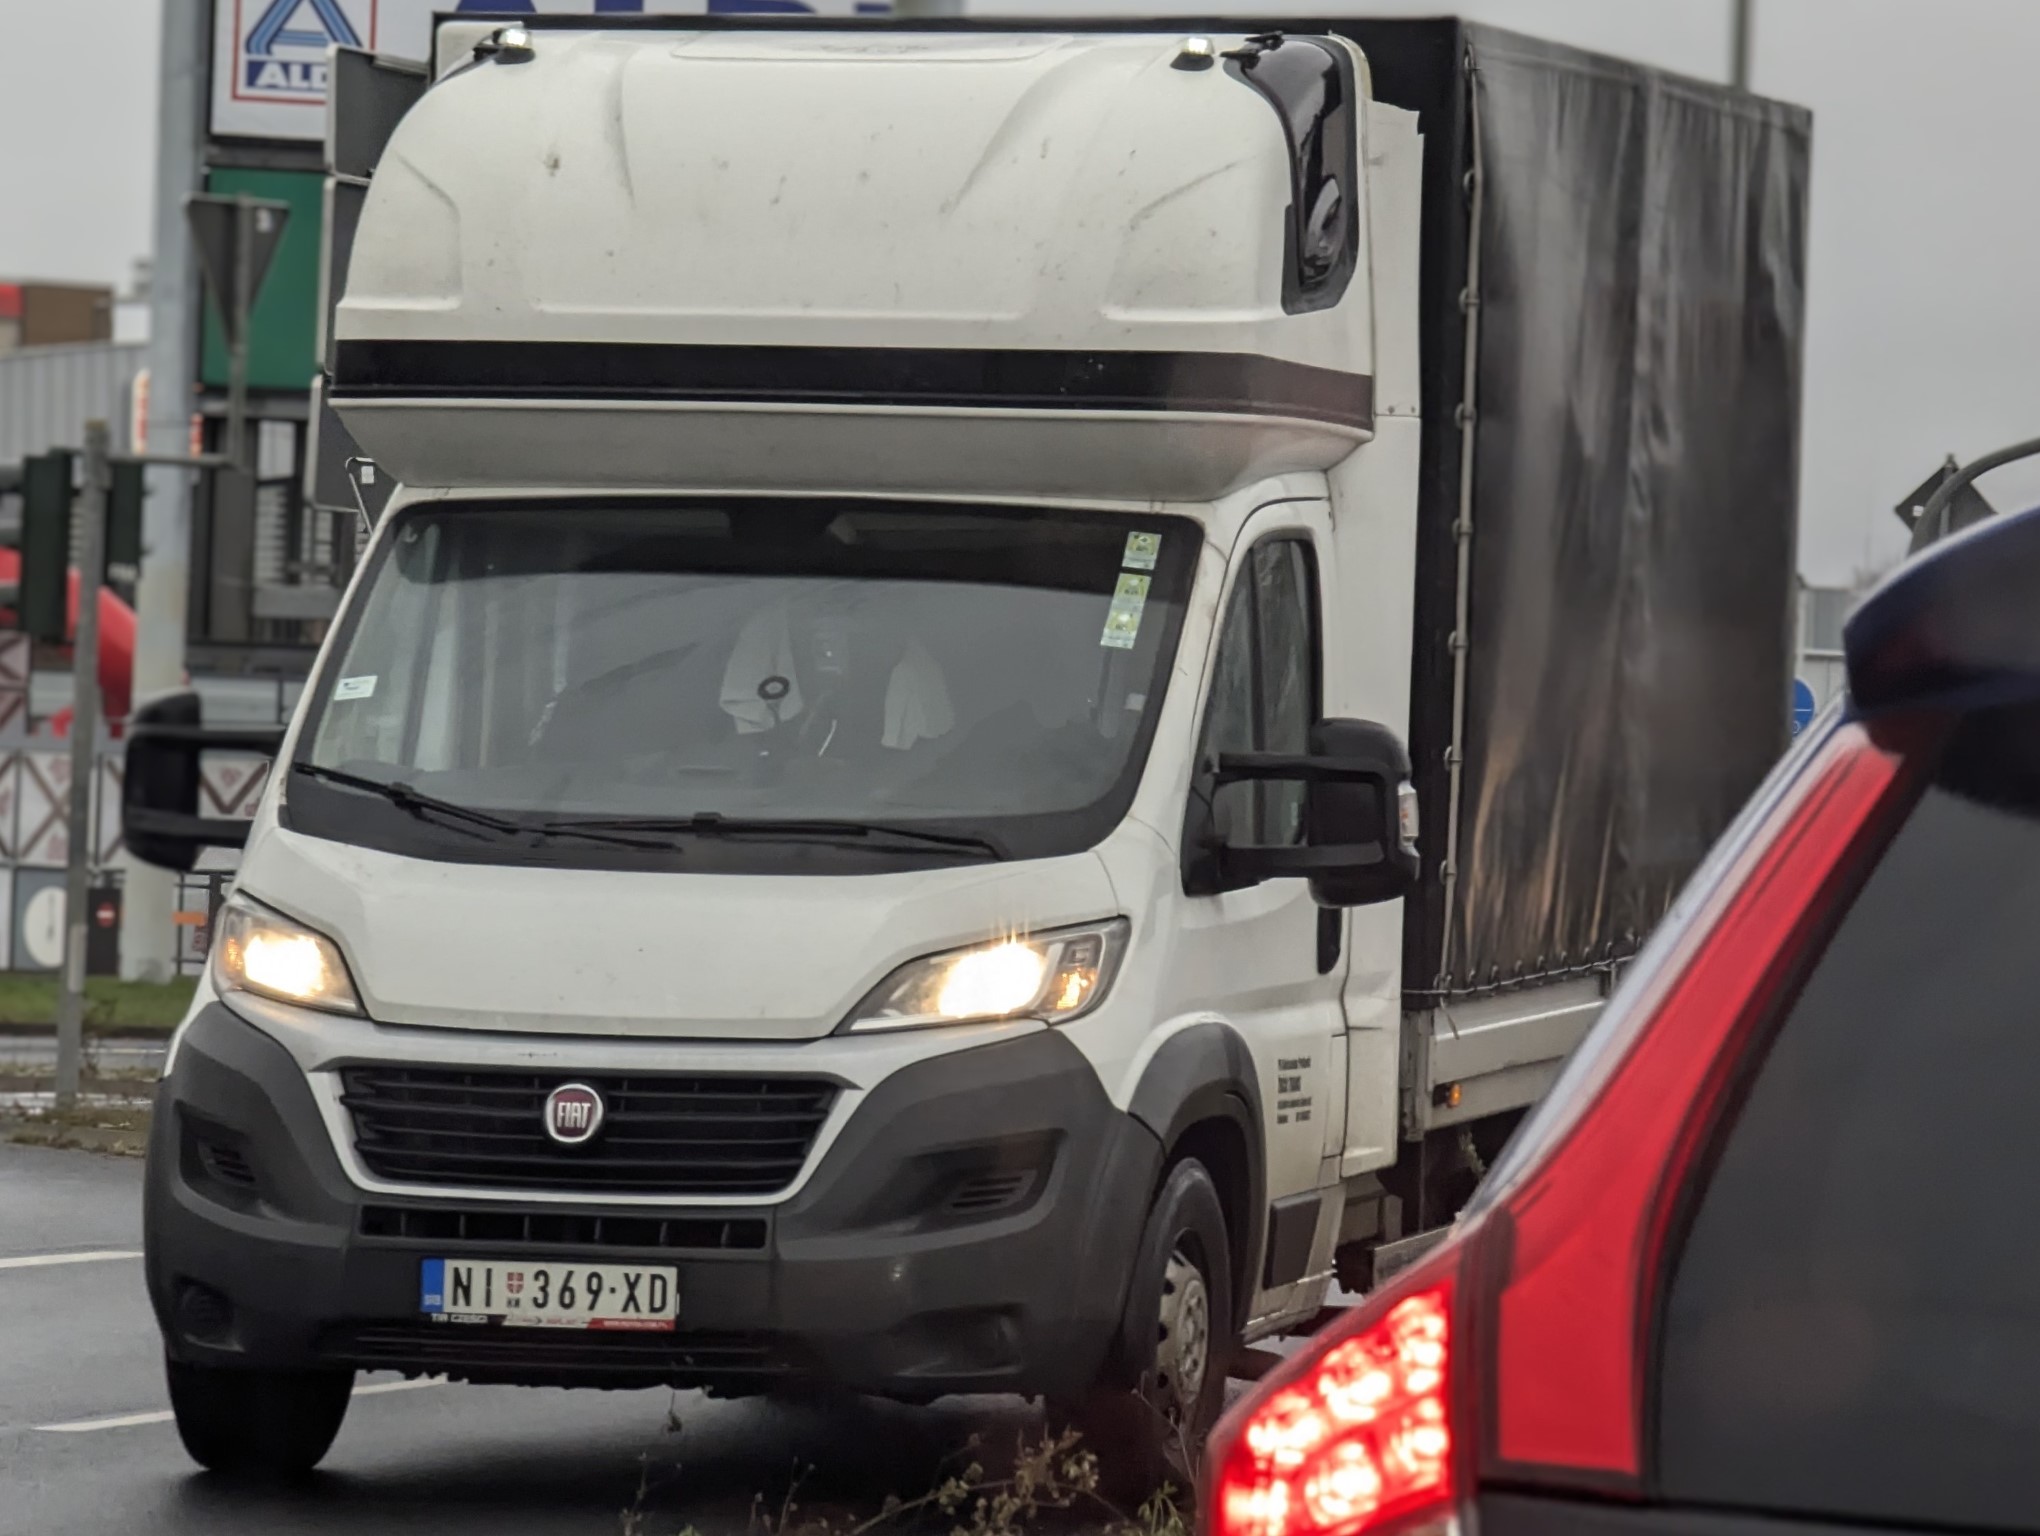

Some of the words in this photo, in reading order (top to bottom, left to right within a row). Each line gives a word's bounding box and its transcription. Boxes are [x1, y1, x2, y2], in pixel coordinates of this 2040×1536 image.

[255, 62, 327, 89] ALD
[557, 1102, 591, 1128] FIAT
[452, 1267, 492, 1307] NI
